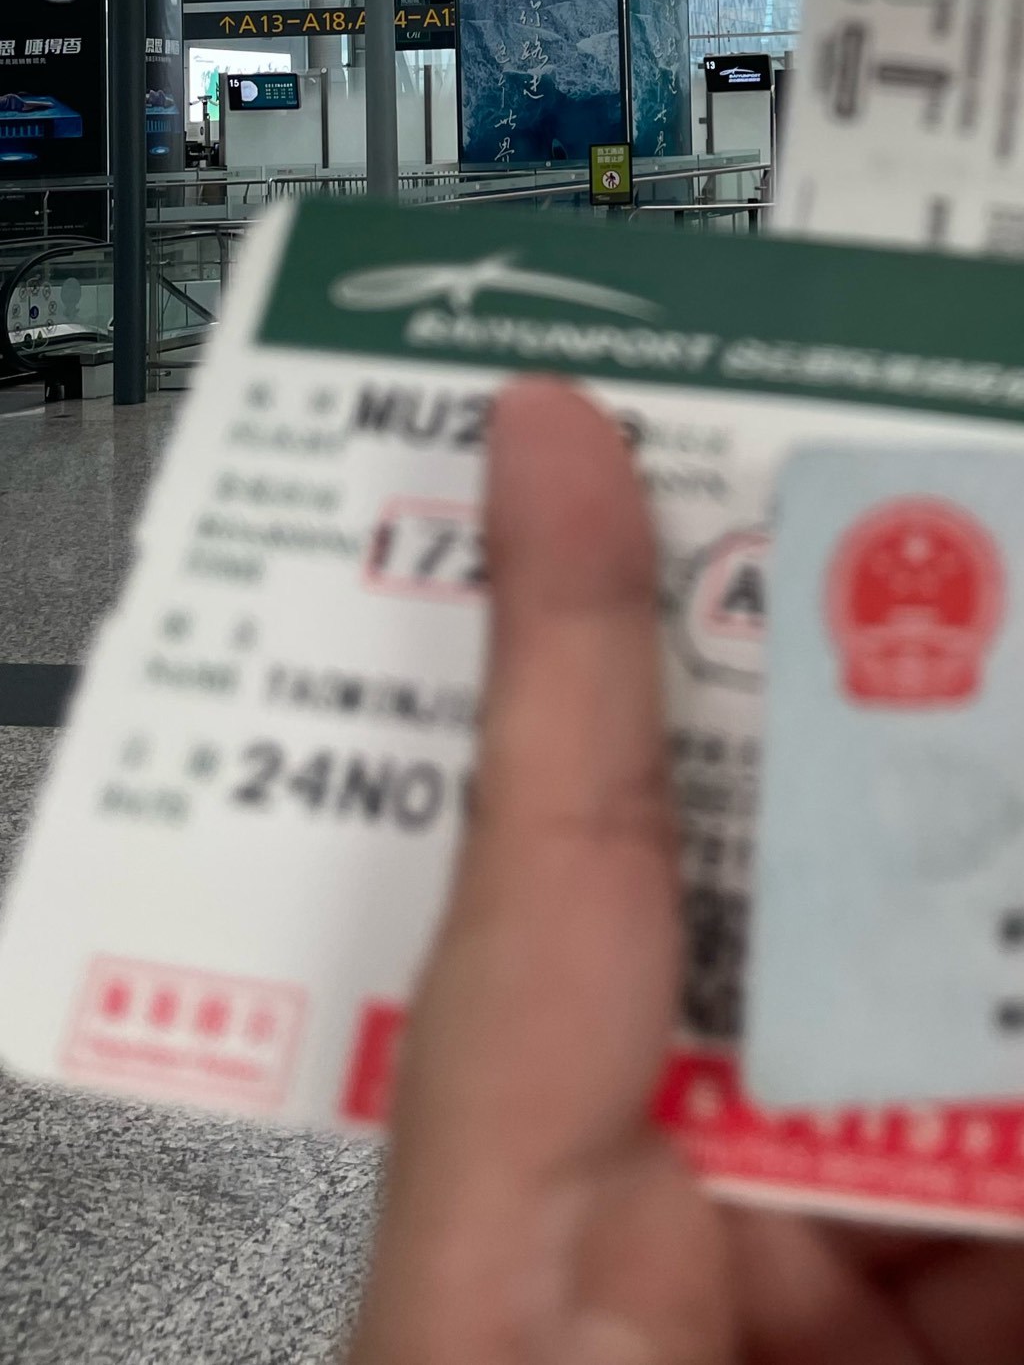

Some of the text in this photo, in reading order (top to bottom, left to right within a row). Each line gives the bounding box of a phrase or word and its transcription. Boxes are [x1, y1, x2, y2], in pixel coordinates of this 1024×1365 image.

[25, 37, 82, 55] 睡得香
[706, 61, 716, 70] 13
[229, 79, 239, 87] 15
[232, 740, 455, 829] 24NO
